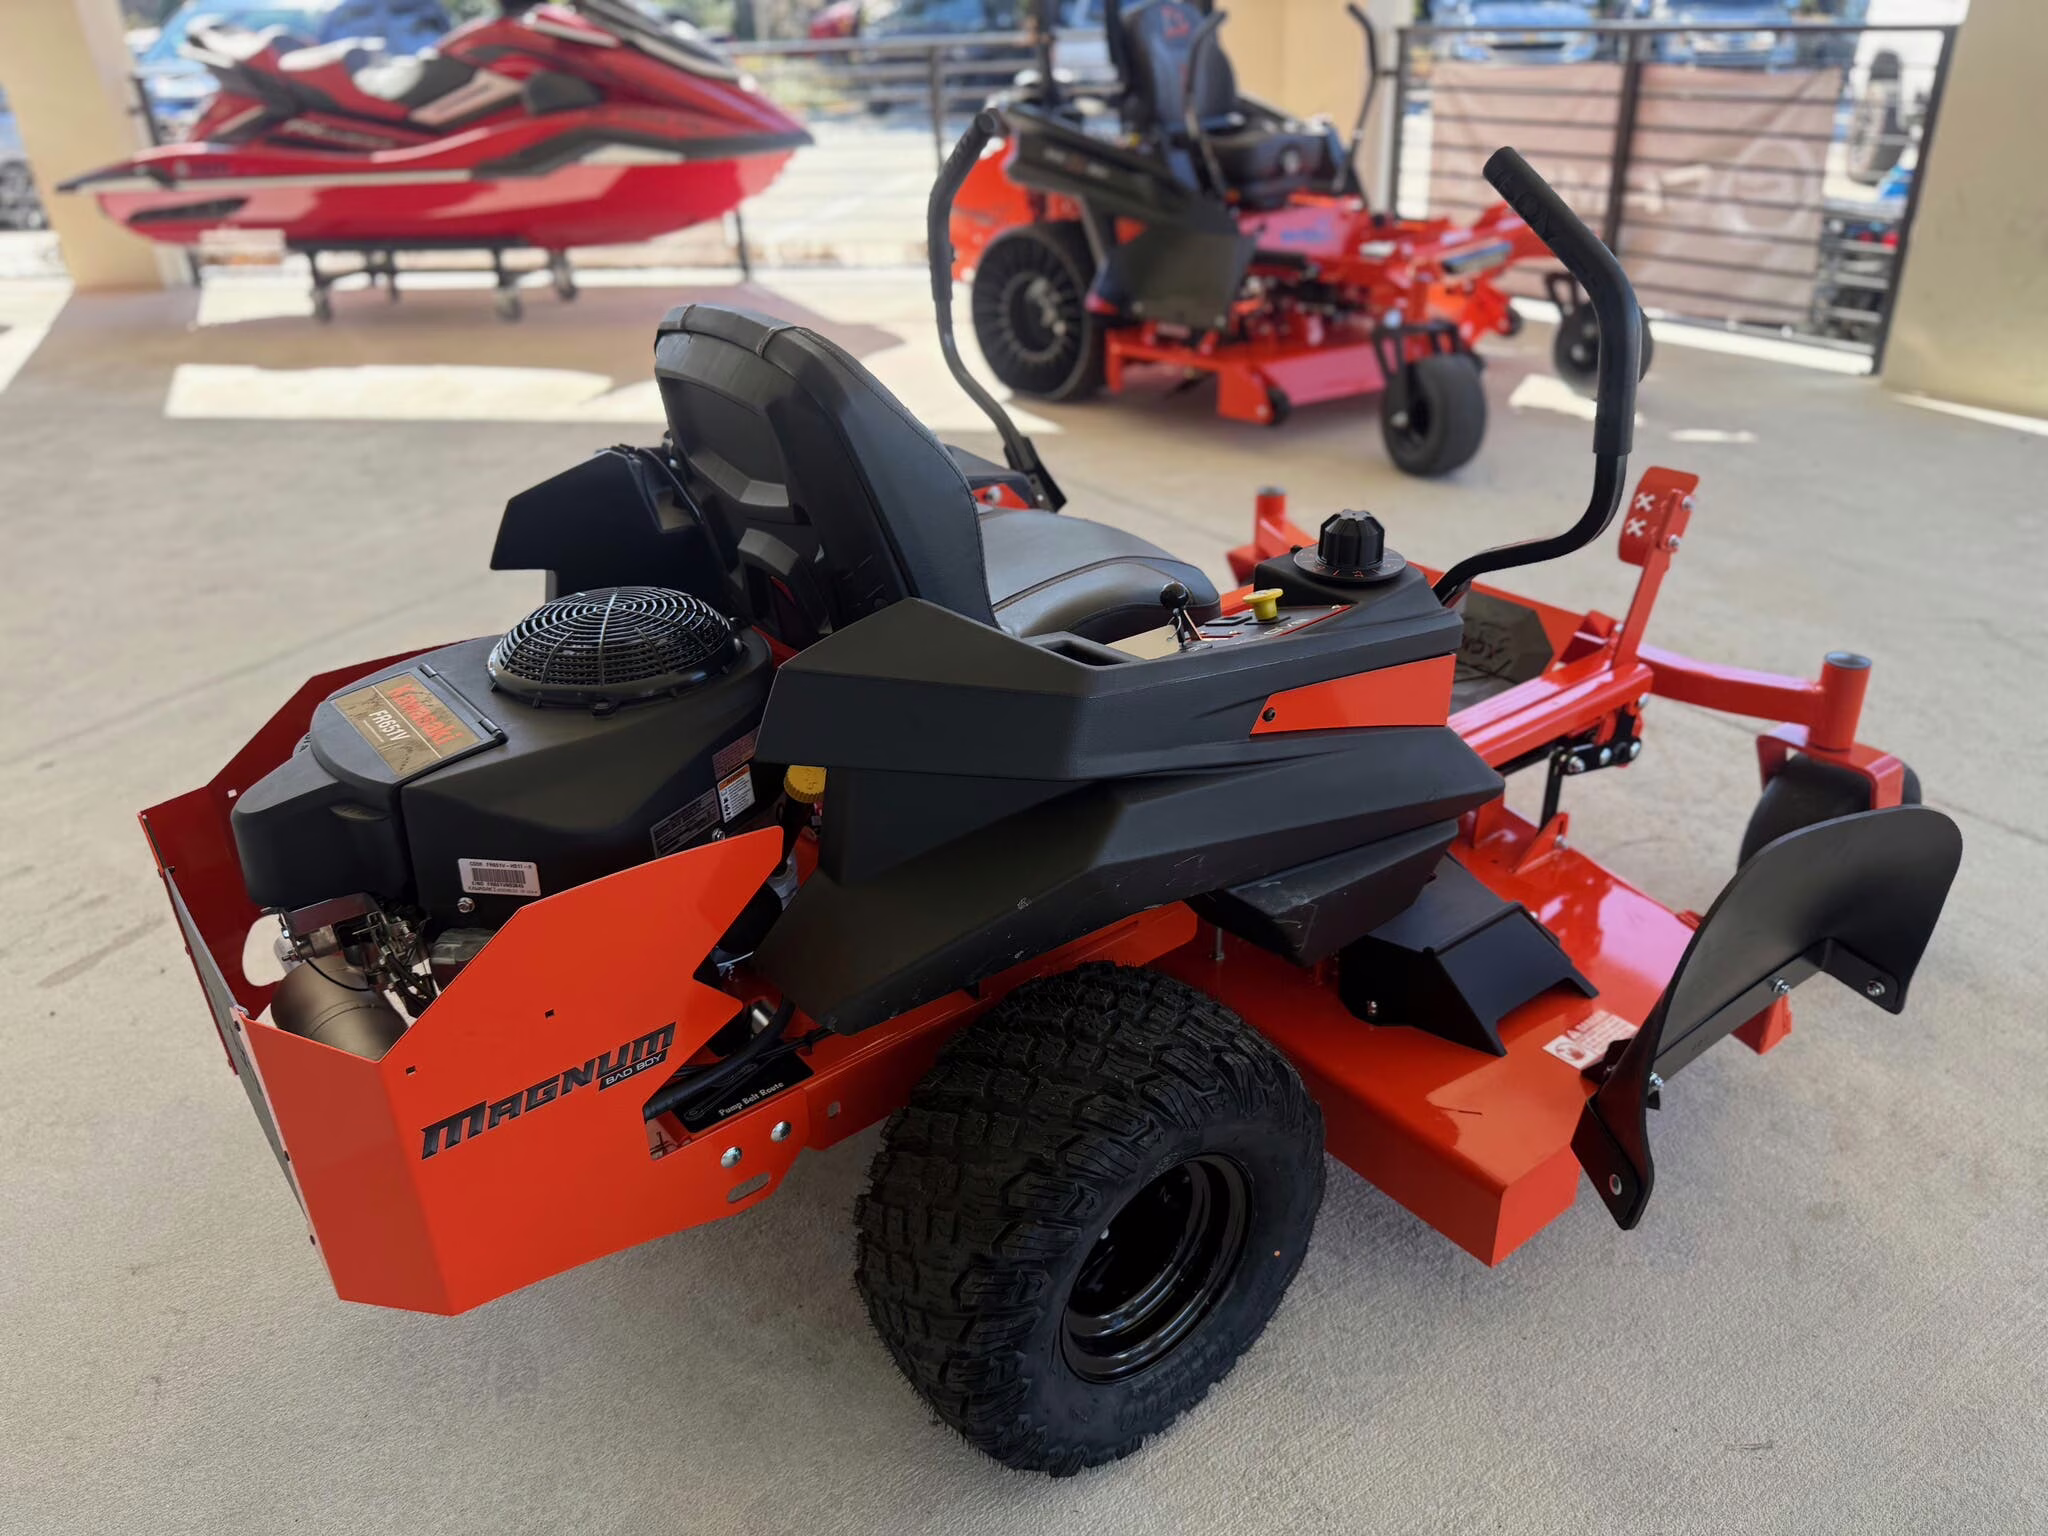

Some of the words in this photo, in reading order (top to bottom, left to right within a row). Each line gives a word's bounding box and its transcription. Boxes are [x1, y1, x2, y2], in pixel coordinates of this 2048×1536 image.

[368, 709, 411, 742] FR651V
[387, 683, 465, 747] Kawasaki
[605, 1067, 633, 1086] BAD
[636, 1053, 662, 1072] BOY
[421, 1021, 677, 1161] MAGNUM
[718, 1102, 743, 1117] Pump
[742, 1092, 760, 1106] Belt
[760, 1081, 785, 1097] Route
